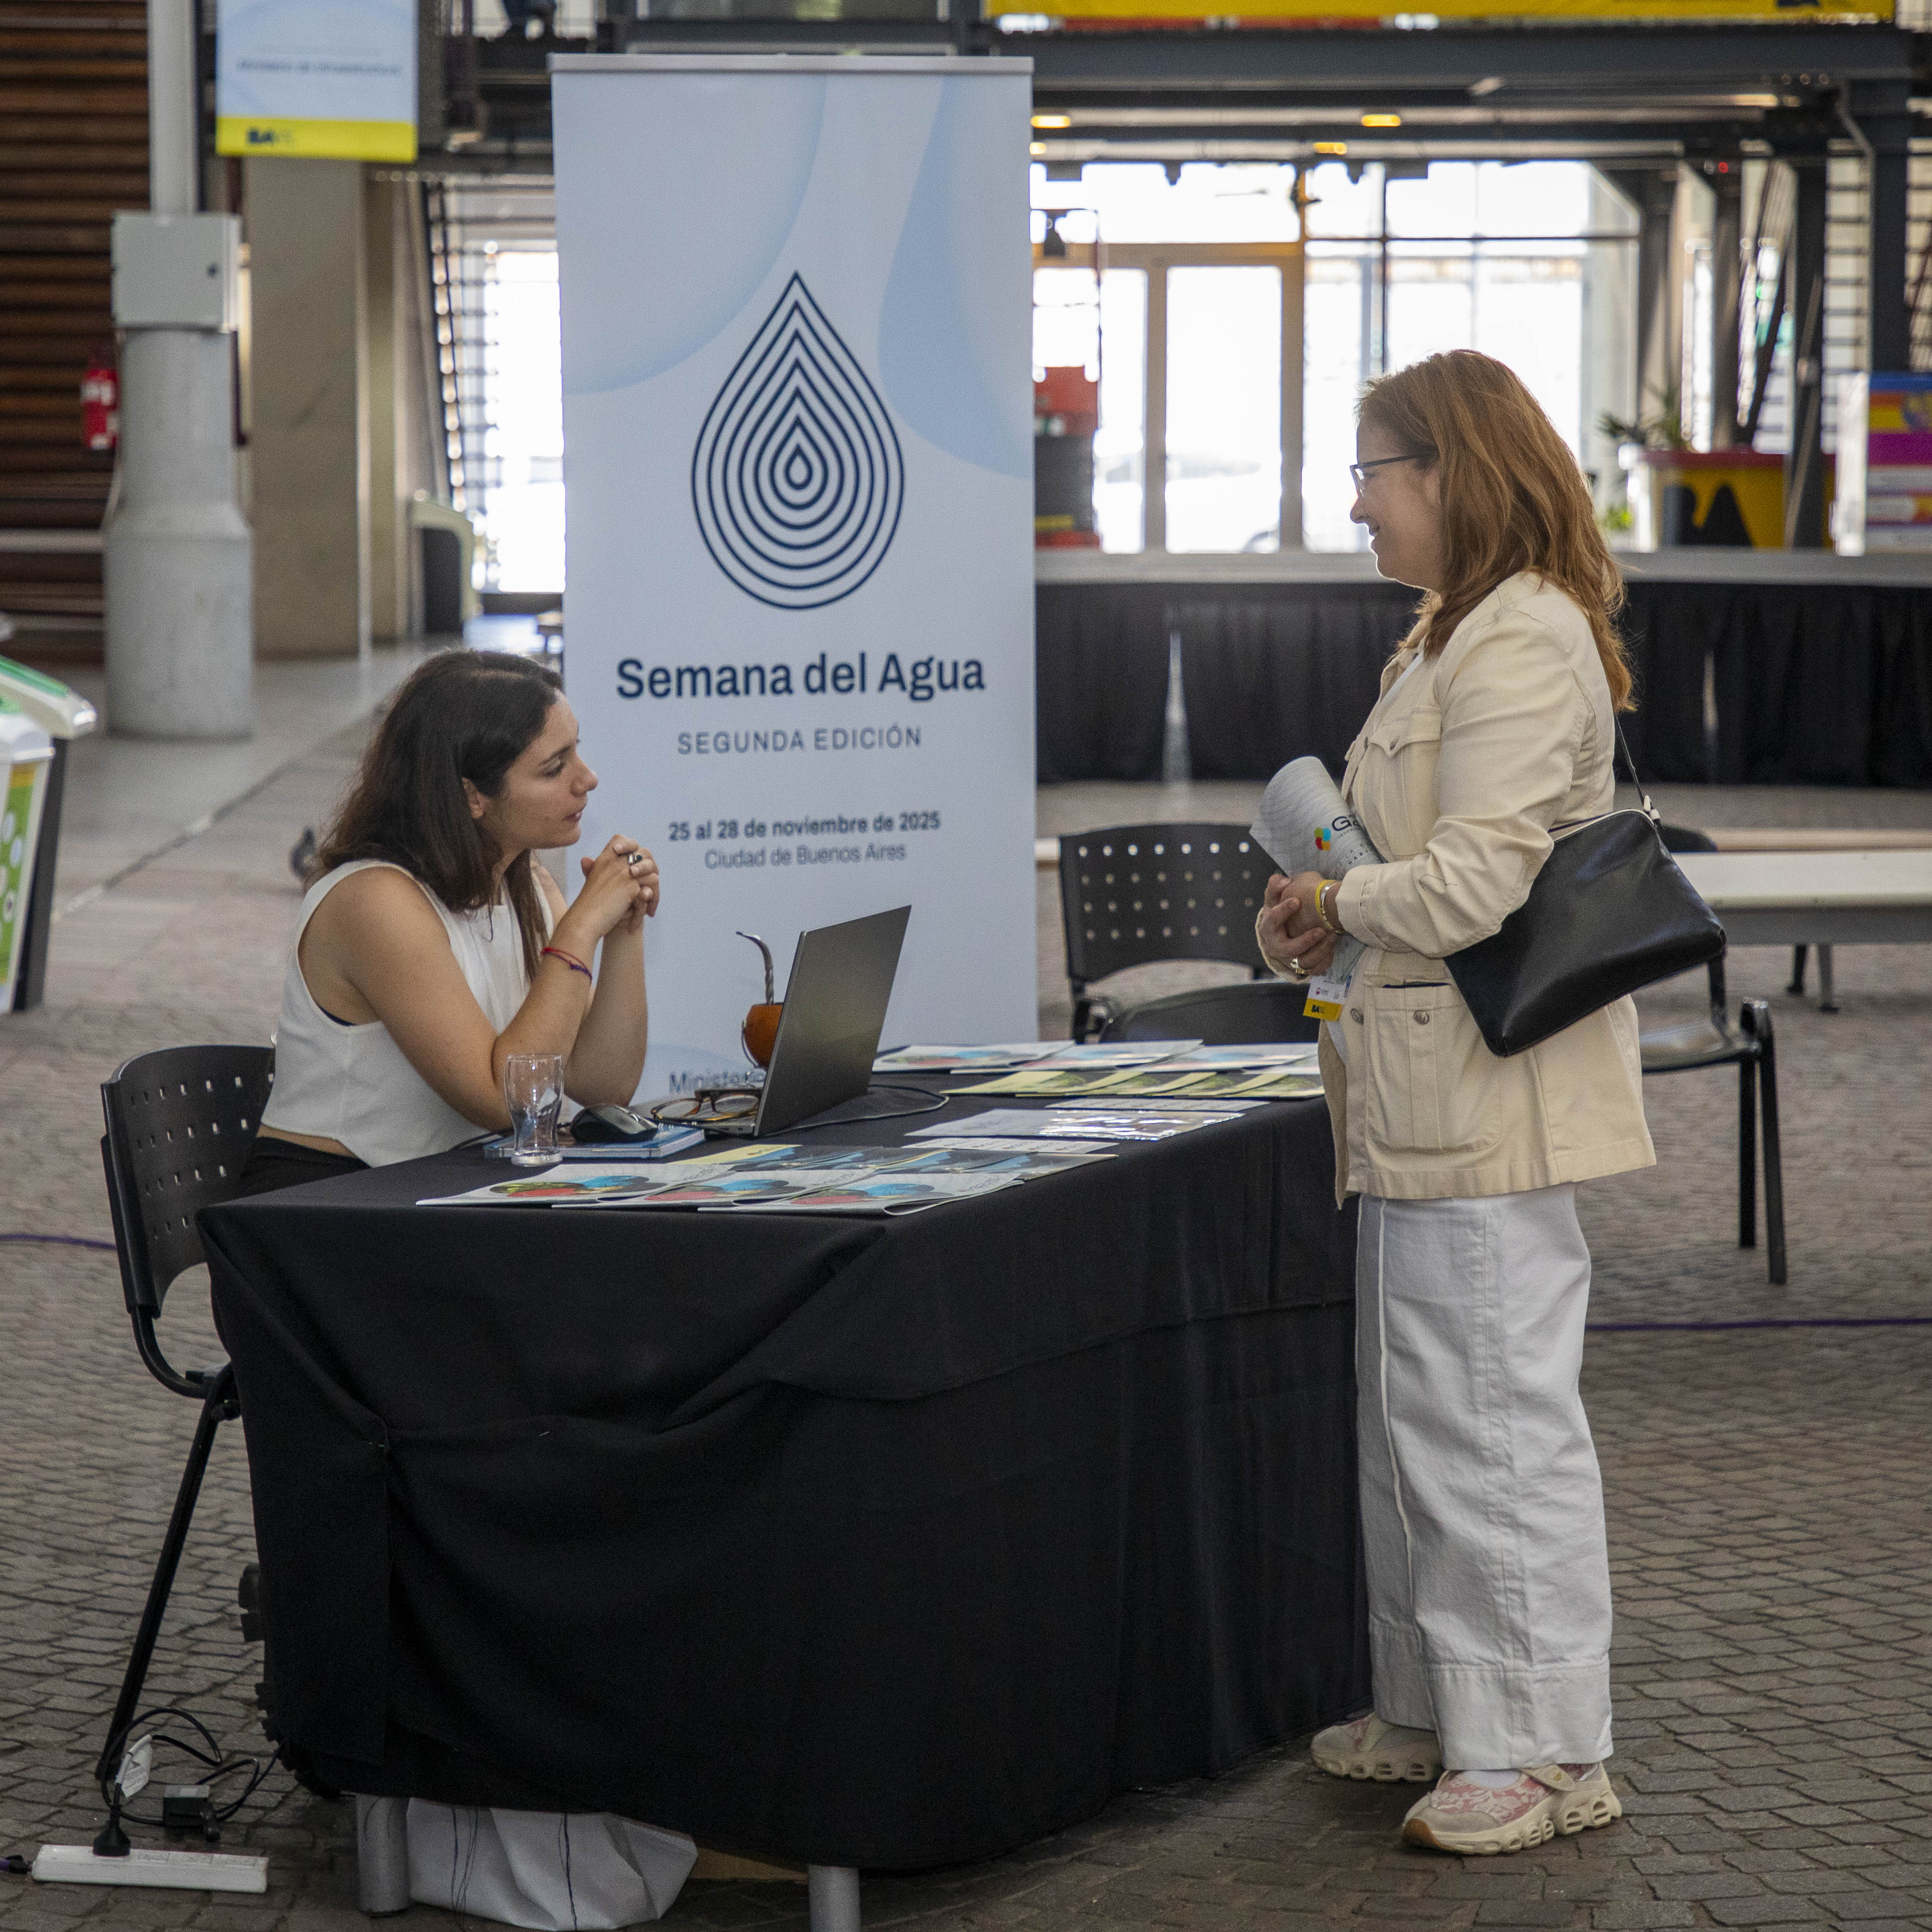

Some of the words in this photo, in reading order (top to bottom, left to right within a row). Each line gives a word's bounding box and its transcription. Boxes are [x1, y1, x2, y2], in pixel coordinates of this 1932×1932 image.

[616, 657, 794, 700] Semana
[803, 651, 867, 695] del
[878, 653, 986, 703] Agua
[677, 729, 805, 755] SEGUNDA
[814, 722, 922, 750] EDICIÓN
[668, 821, 691, 841] 25
[695, 820, 711, 840] al
[717, 819, 739, 839] 28
[744, 817, 767, 838] de
[772, 813, 868, 837] noviembre
[873, 812, 895, 832] de
[899, 810, 941, 831] 2025
[704, 846, 767, 869] Ciudad
[770, 847, 793, 866] de
[796, 844, 862, 865] Buenos
[865, 842, 907, 861] Aires
